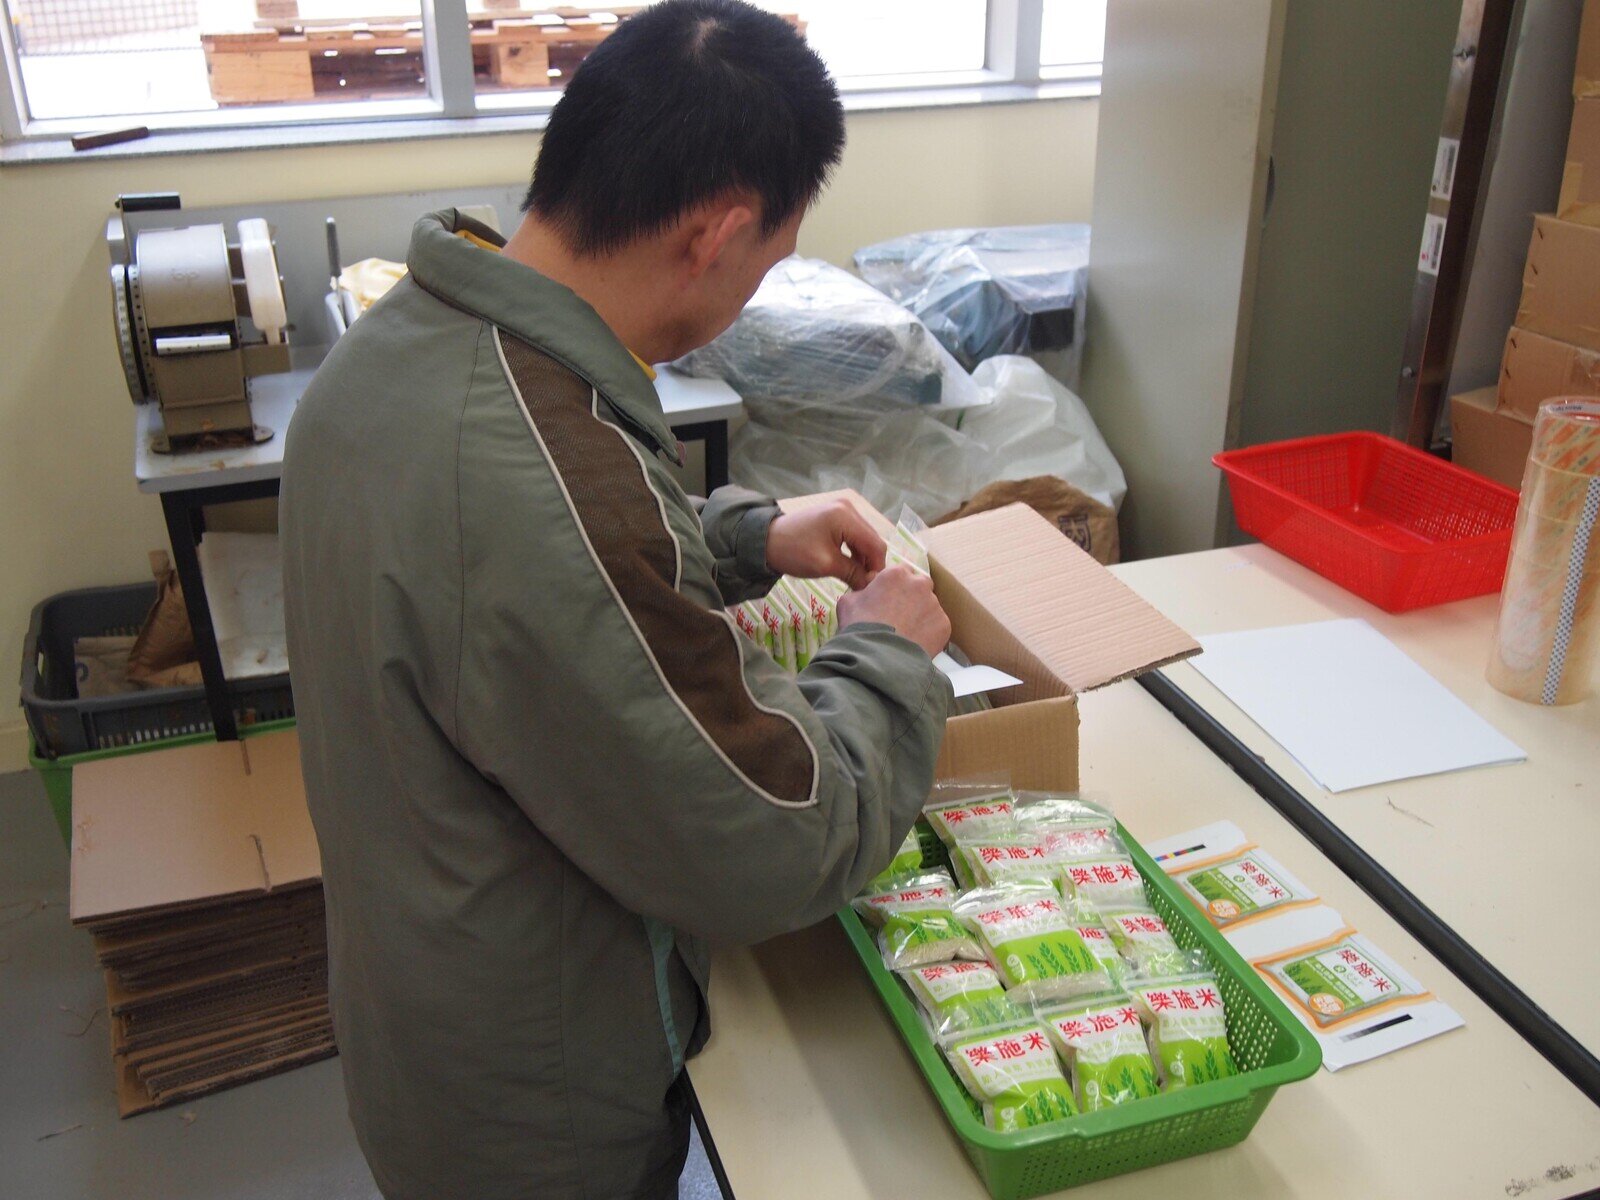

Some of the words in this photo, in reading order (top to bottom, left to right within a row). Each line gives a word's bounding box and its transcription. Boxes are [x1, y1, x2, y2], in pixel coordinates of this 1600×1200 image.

[1068, 863, 1140, 887] 樂施米
[1238, 861, 1283, 898] 樂施米
[976, 898, 1060, 926] 樂施米
[1337, 949, 1391, 993] 樂施米
[1145, 987, 1222, 1013] 樂施米
[1058, 1006, 1142, 1041] 樂施米
[964, 1031, 1051, 1067] 樂施米
